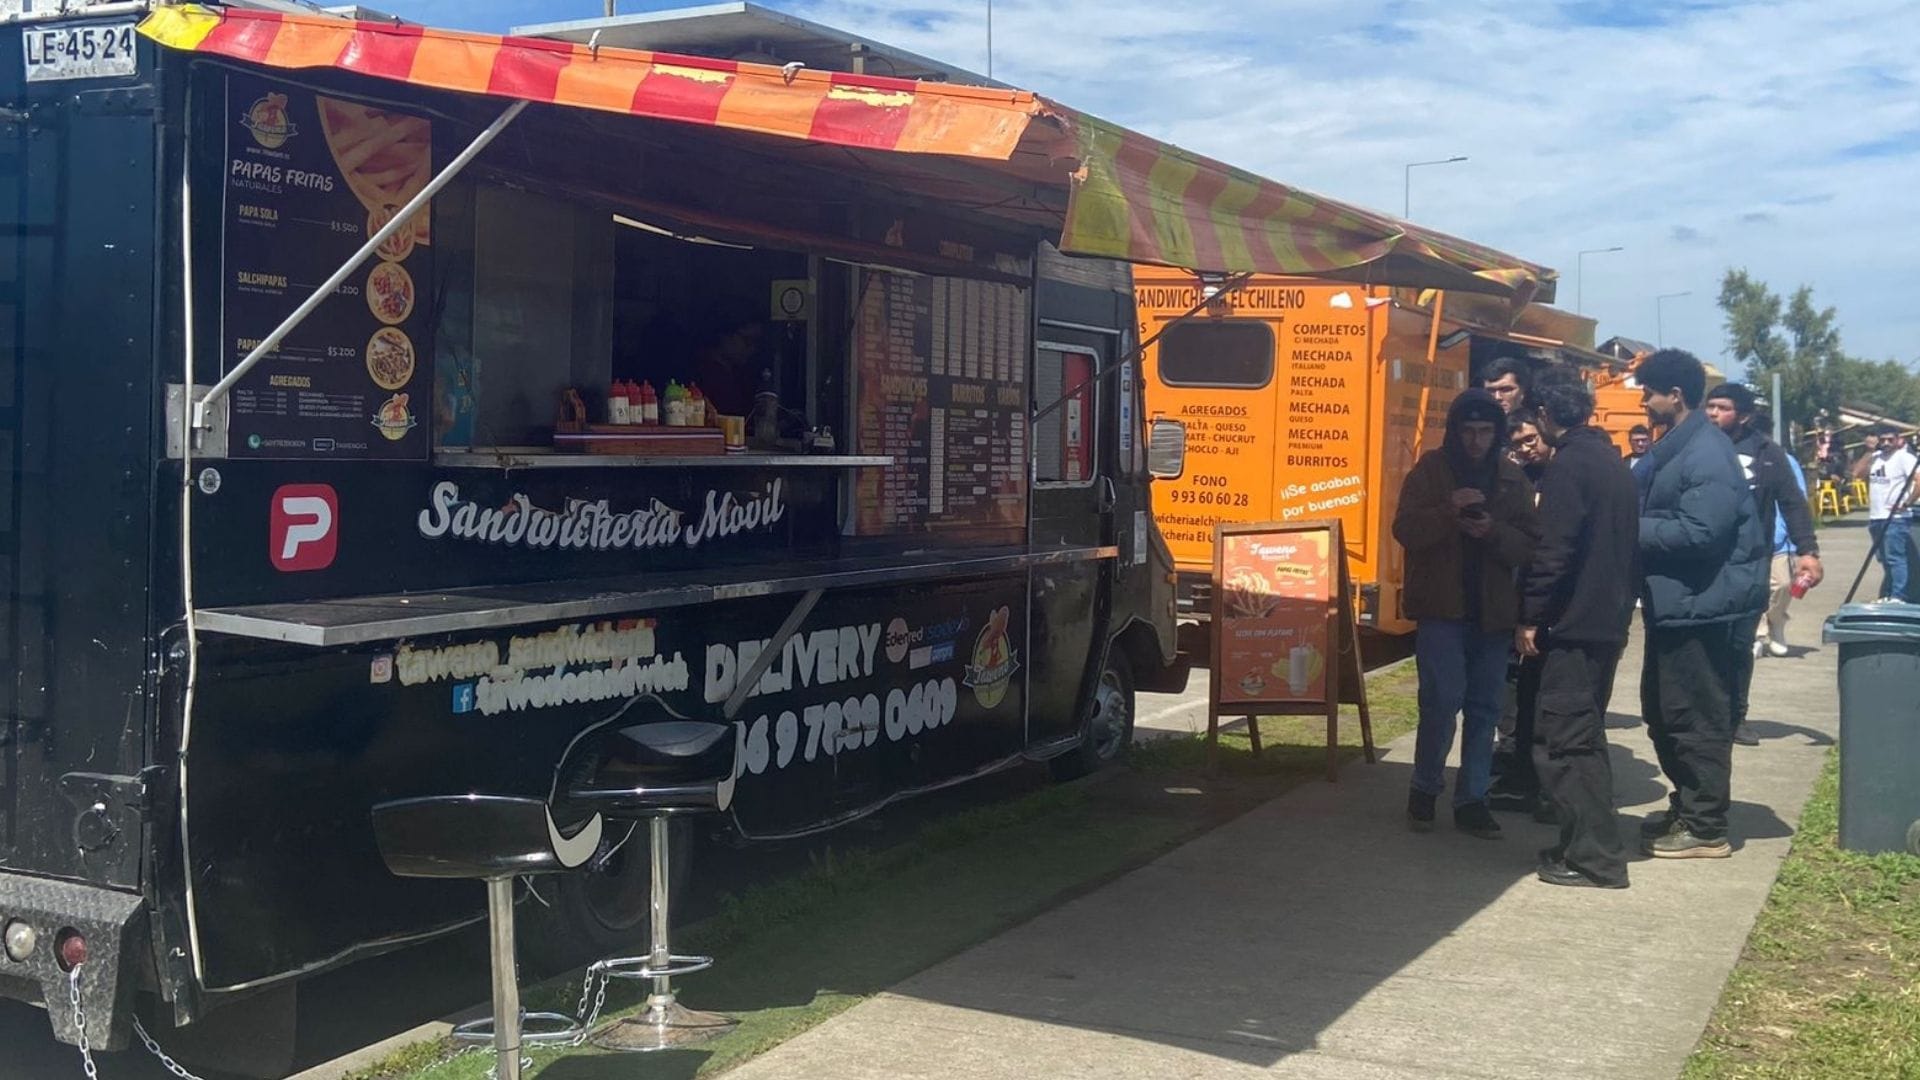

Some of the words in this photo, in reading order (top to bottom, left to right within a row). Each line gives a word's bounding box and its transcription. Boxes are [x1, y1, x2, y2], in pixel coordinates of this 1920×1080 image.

[232, 160, 281, 183] PAPAS
[286, 169, 333, 192] FRITAS
[232, 179, 282, 194] NATURALES
[239, 204, 258, 217] PAPA
[260, 207, 278, 220] SOLA
[238, 271, 287, 287] SALCHIPAPAS
[1232, 289, 1246, 308] EL
[1249, 288, 1305, 308] CHILENO
[1293, 324, 1366, 336] COMPLETOS
[1291, 350, 1353, 361] MECHADA
[269, 375, 311, 388] AGREGADOS
[1290, 376, 1345, 388] MECHADA
[1181, 405, 1247, 416] AGREGADOS
[1289, 402, 1350, 415] MECHADA
[1288, 415, 1314, 423] QUESO
[1183, 421, 1208, 431] ALTA
[1215, 422, 1246, 432] QUESO
[1213, 434, 1256, 444] CHUCRUT
[1288, 428, 1349, 440] MECHADA
[1287, 455, 1349, 468] BURRITOS
[1193, 474, 1227, 487] FONO
[1310, 475, 1361, 492] acaban
[1171, 490, 1178, 502] 9
[1181, 491, 1195, 503] 93
[1199, 491, 1213, 504] 60
[1216, 492, 1231, 505] 60
[1233, 493, 1248, 507] 28
[1283, 506, 1305, 520] por
[885, 625, 924, 648] Edenred
[776, 710, 798, 769] 9
